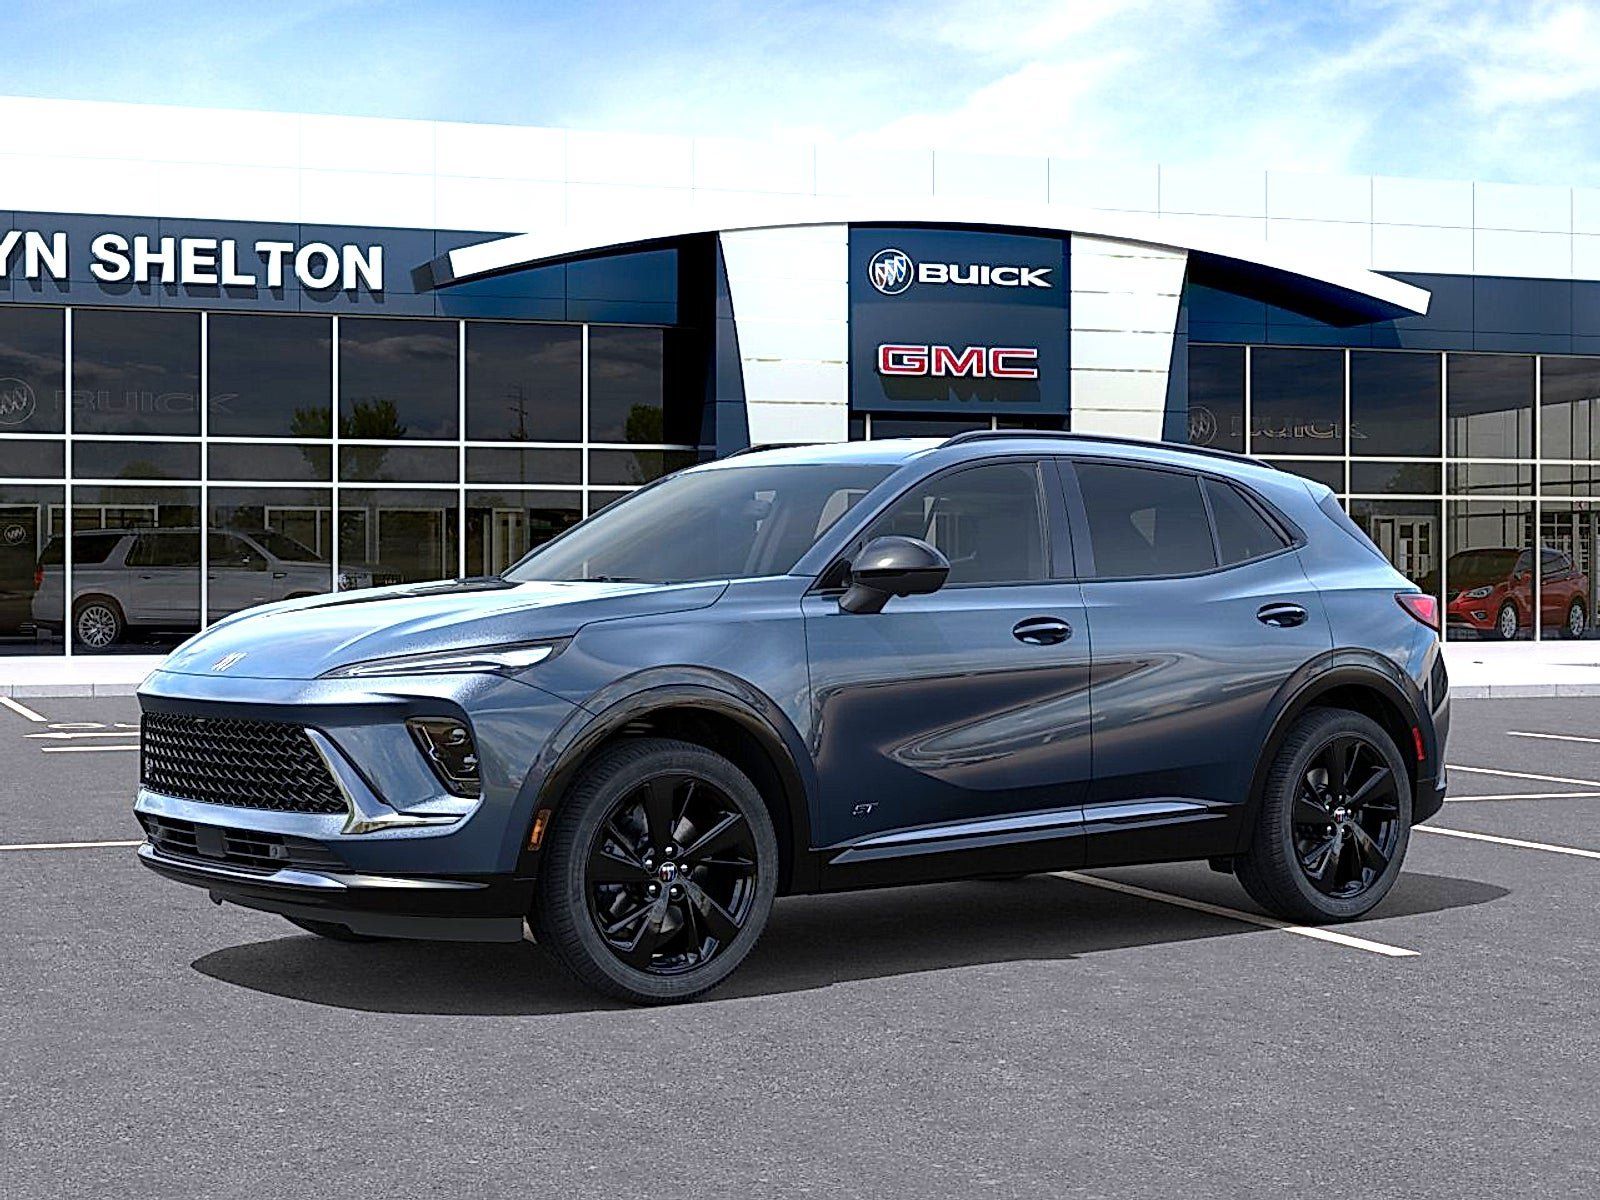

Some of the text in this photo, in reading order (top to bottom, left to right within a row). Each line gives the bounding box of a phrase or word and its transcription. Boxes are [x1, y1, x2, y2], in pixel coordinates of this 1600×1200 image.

[90, 233, 384, 290] SHELTON
[918, 263, 1053, 288] BUICK
[878, 344, 1038, 378] GMC
